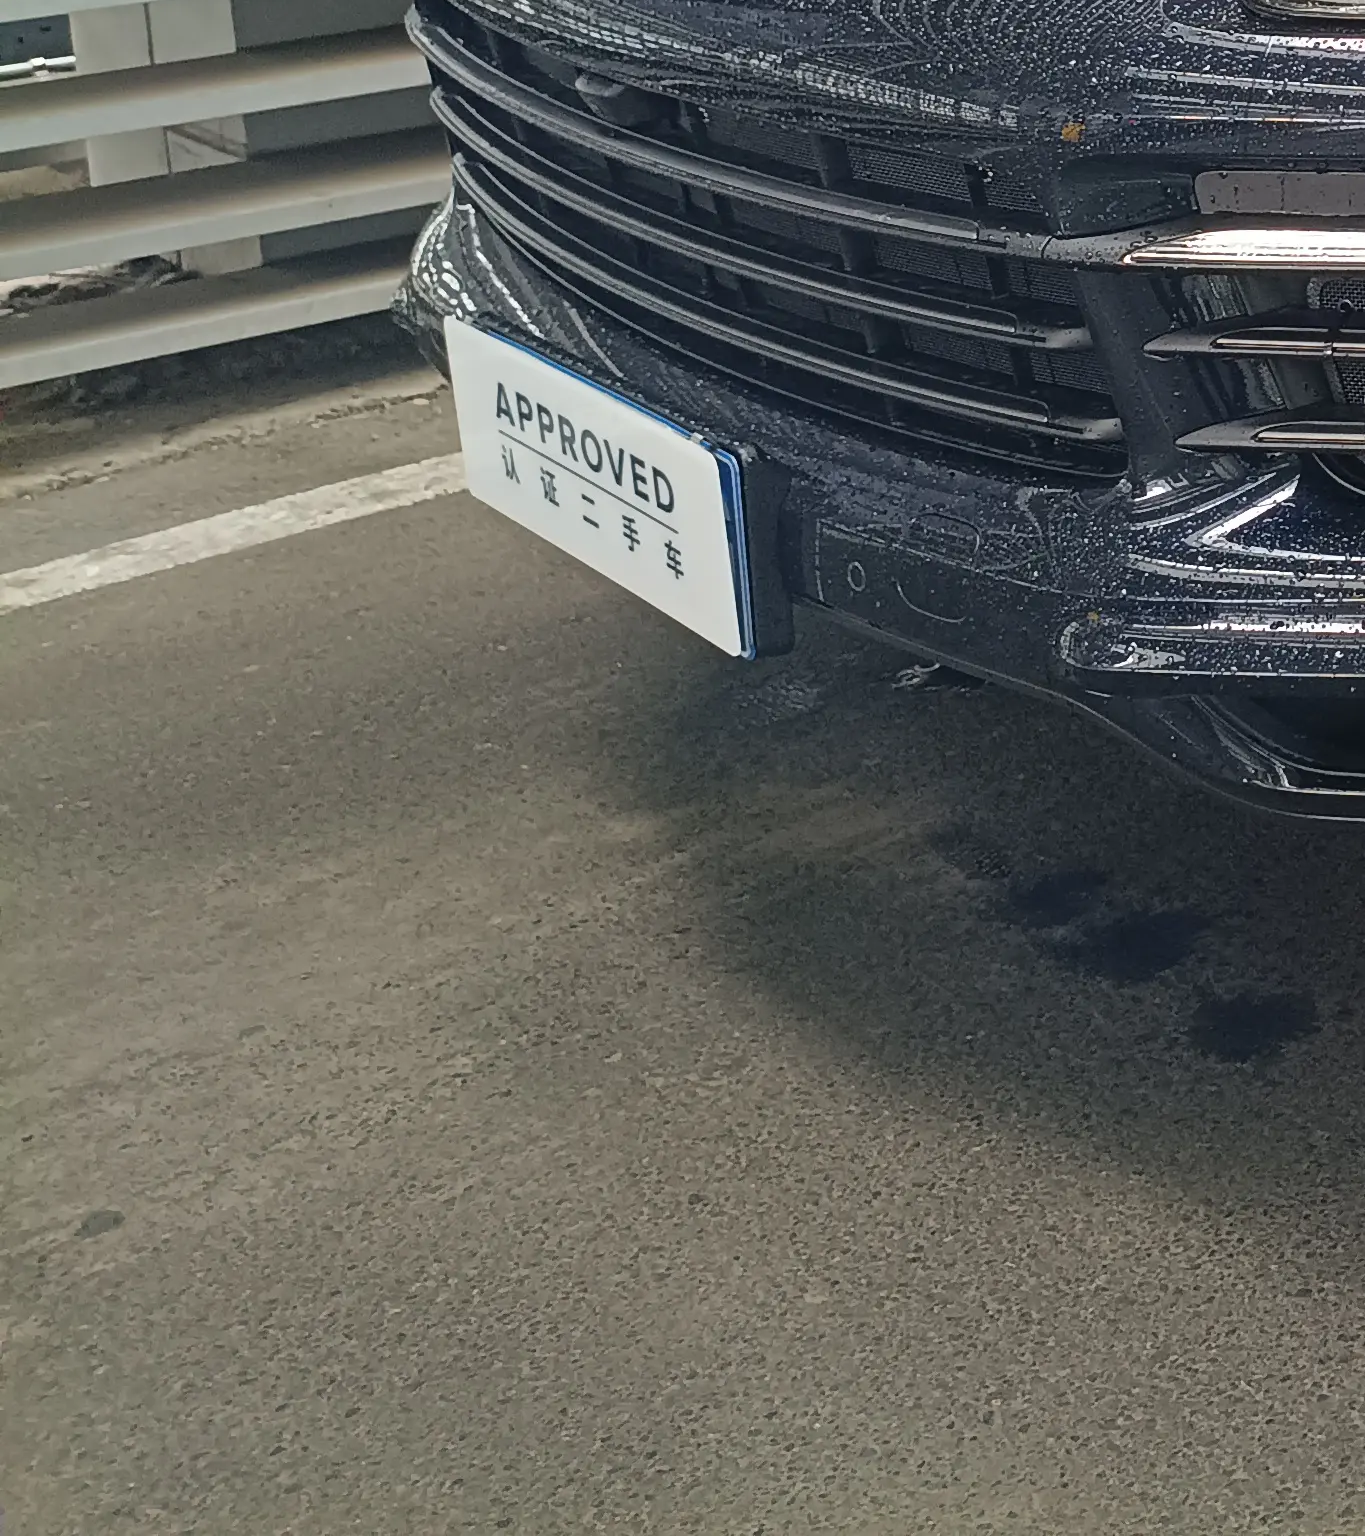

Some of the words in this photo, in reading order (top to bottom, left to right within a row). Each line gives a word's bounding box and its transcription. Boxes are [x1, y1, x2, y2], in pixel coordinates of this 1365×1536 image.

[495, 381, 676, 514] APPROVED
[500, 444, 685, 580] 认证二手车
